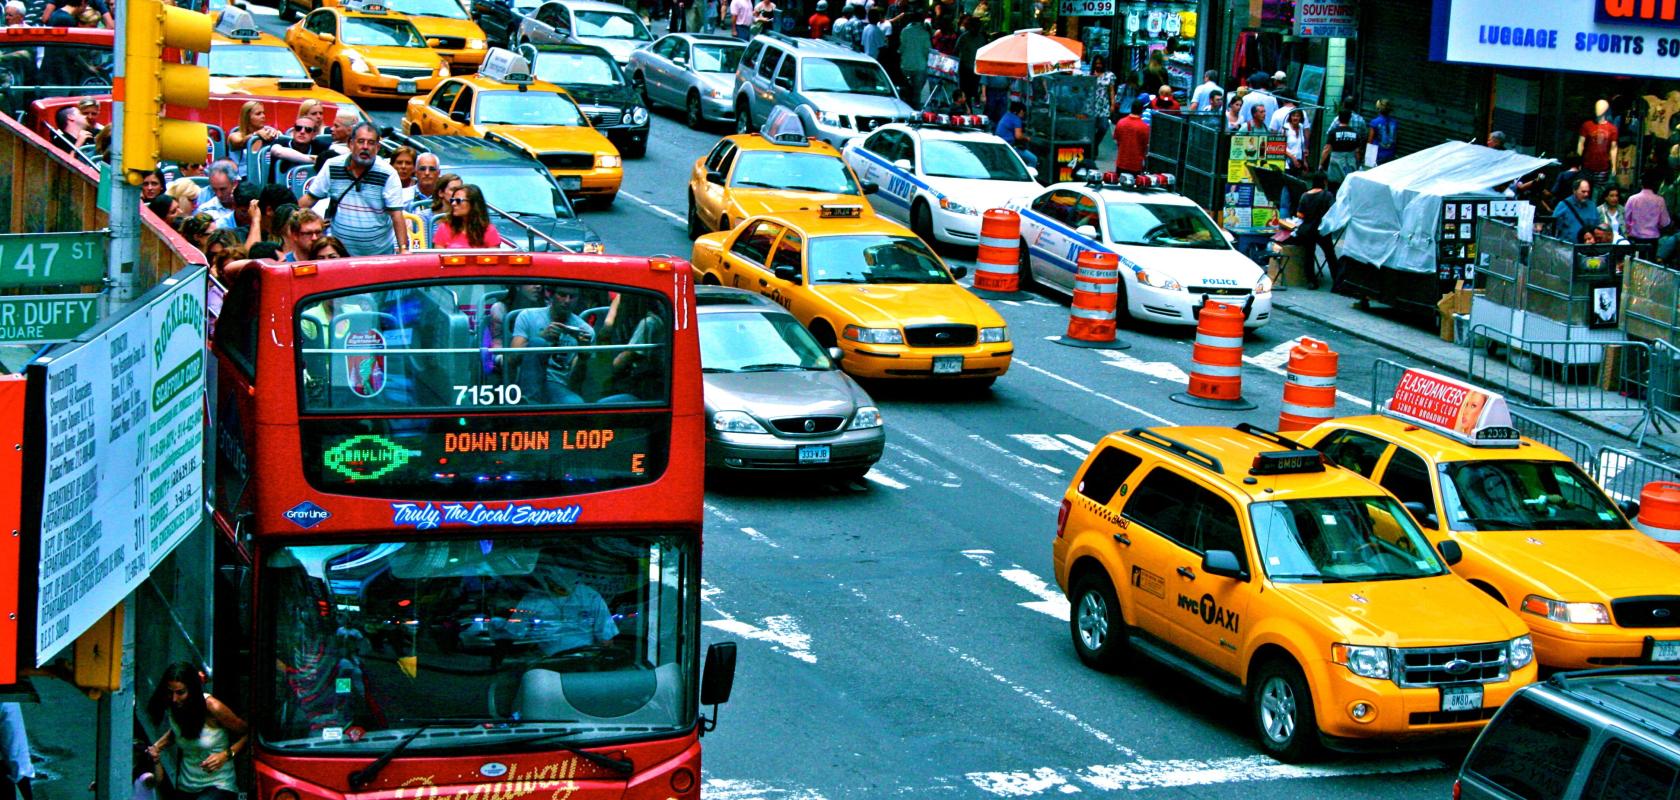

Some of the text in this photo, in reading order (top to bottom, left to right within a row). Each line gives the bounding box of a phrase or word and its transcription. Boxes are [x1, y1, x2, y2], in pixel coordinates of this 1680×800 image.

[1083, 2, 1112, 12] 10.99
[1303, 4, 1354, 16] SOUVENIRS
[1479, 25, 1557, 49] LUGGAGE
[1575, 31, 1644, 55] SPORTS
[887, 175, 911, 199] NYPD
[14, 243, 60, 277] 47
[72, 242, 96, 260] ST
[1202, 278, 1238, 286] POLICE
[24, 300, 93, 325] DUFFY
[155, 293, 202, 370] ROCKLEDGE
[454, 384, 522, 406] 71510
[1400, 373, 1467, 406] FLASHDANCERS
[1395, 389, 1458, 417] GENTLEMEN'S CLUB
[1419, 410, 1449, 425] BROADWAY
[445, 429, 614, 453] DOWNTOWN LOOP
[631, 453, 646, 474] E
[133, 471, 143, 510] 311
[393, 502, 580, 530] Truly, The Local Expert!
[134, 511, 144, 552] 311
[1177, 593, 1240, 634] NYC TAXI
